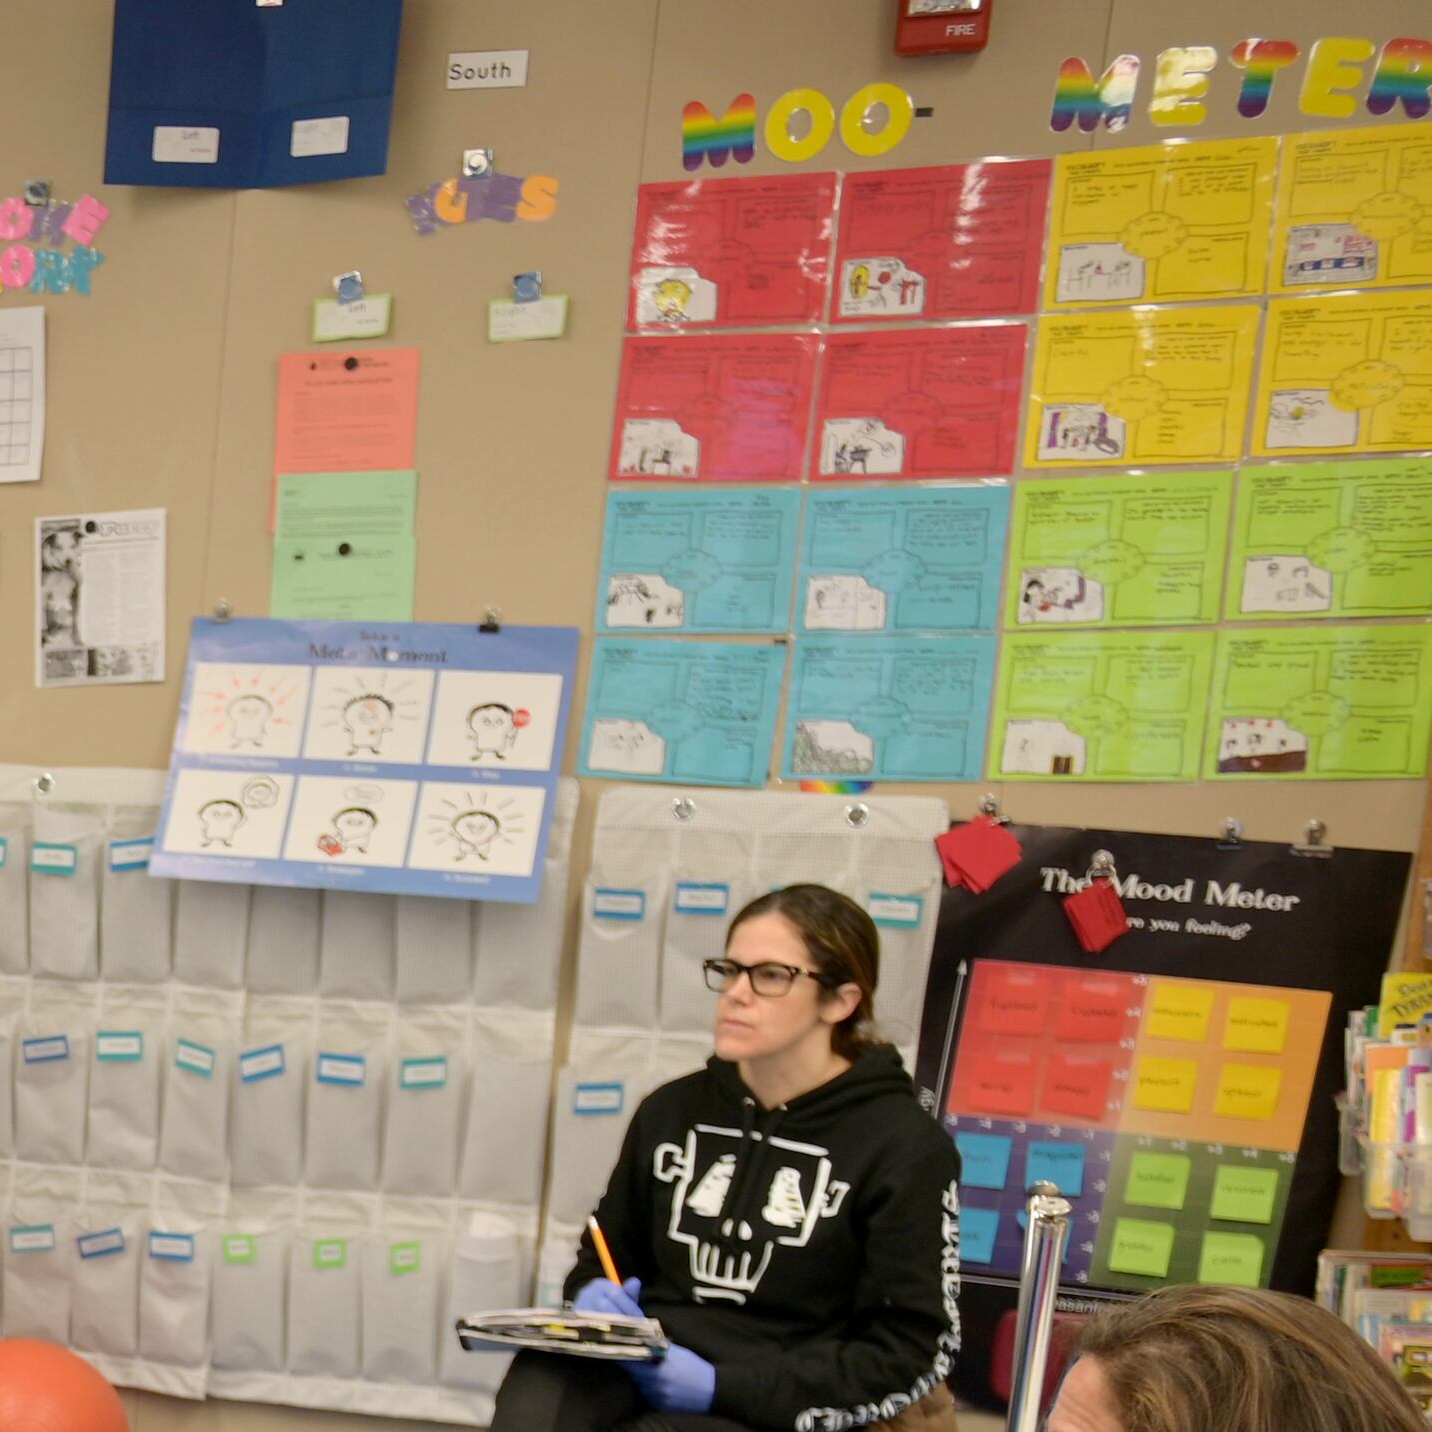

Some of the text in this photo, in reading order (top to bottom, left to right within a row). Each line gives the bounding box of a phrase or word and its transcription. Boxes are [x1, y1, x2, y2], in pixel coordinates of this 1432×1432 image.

[943, 22, 977, 38] FIRE
[448, 62, 512, 82] South
[1049, 37, 1432, 134] METER
[1040, 868, 1300, 911] The Mood Meter
[1150, 918, 1251, 940] you feeling?
